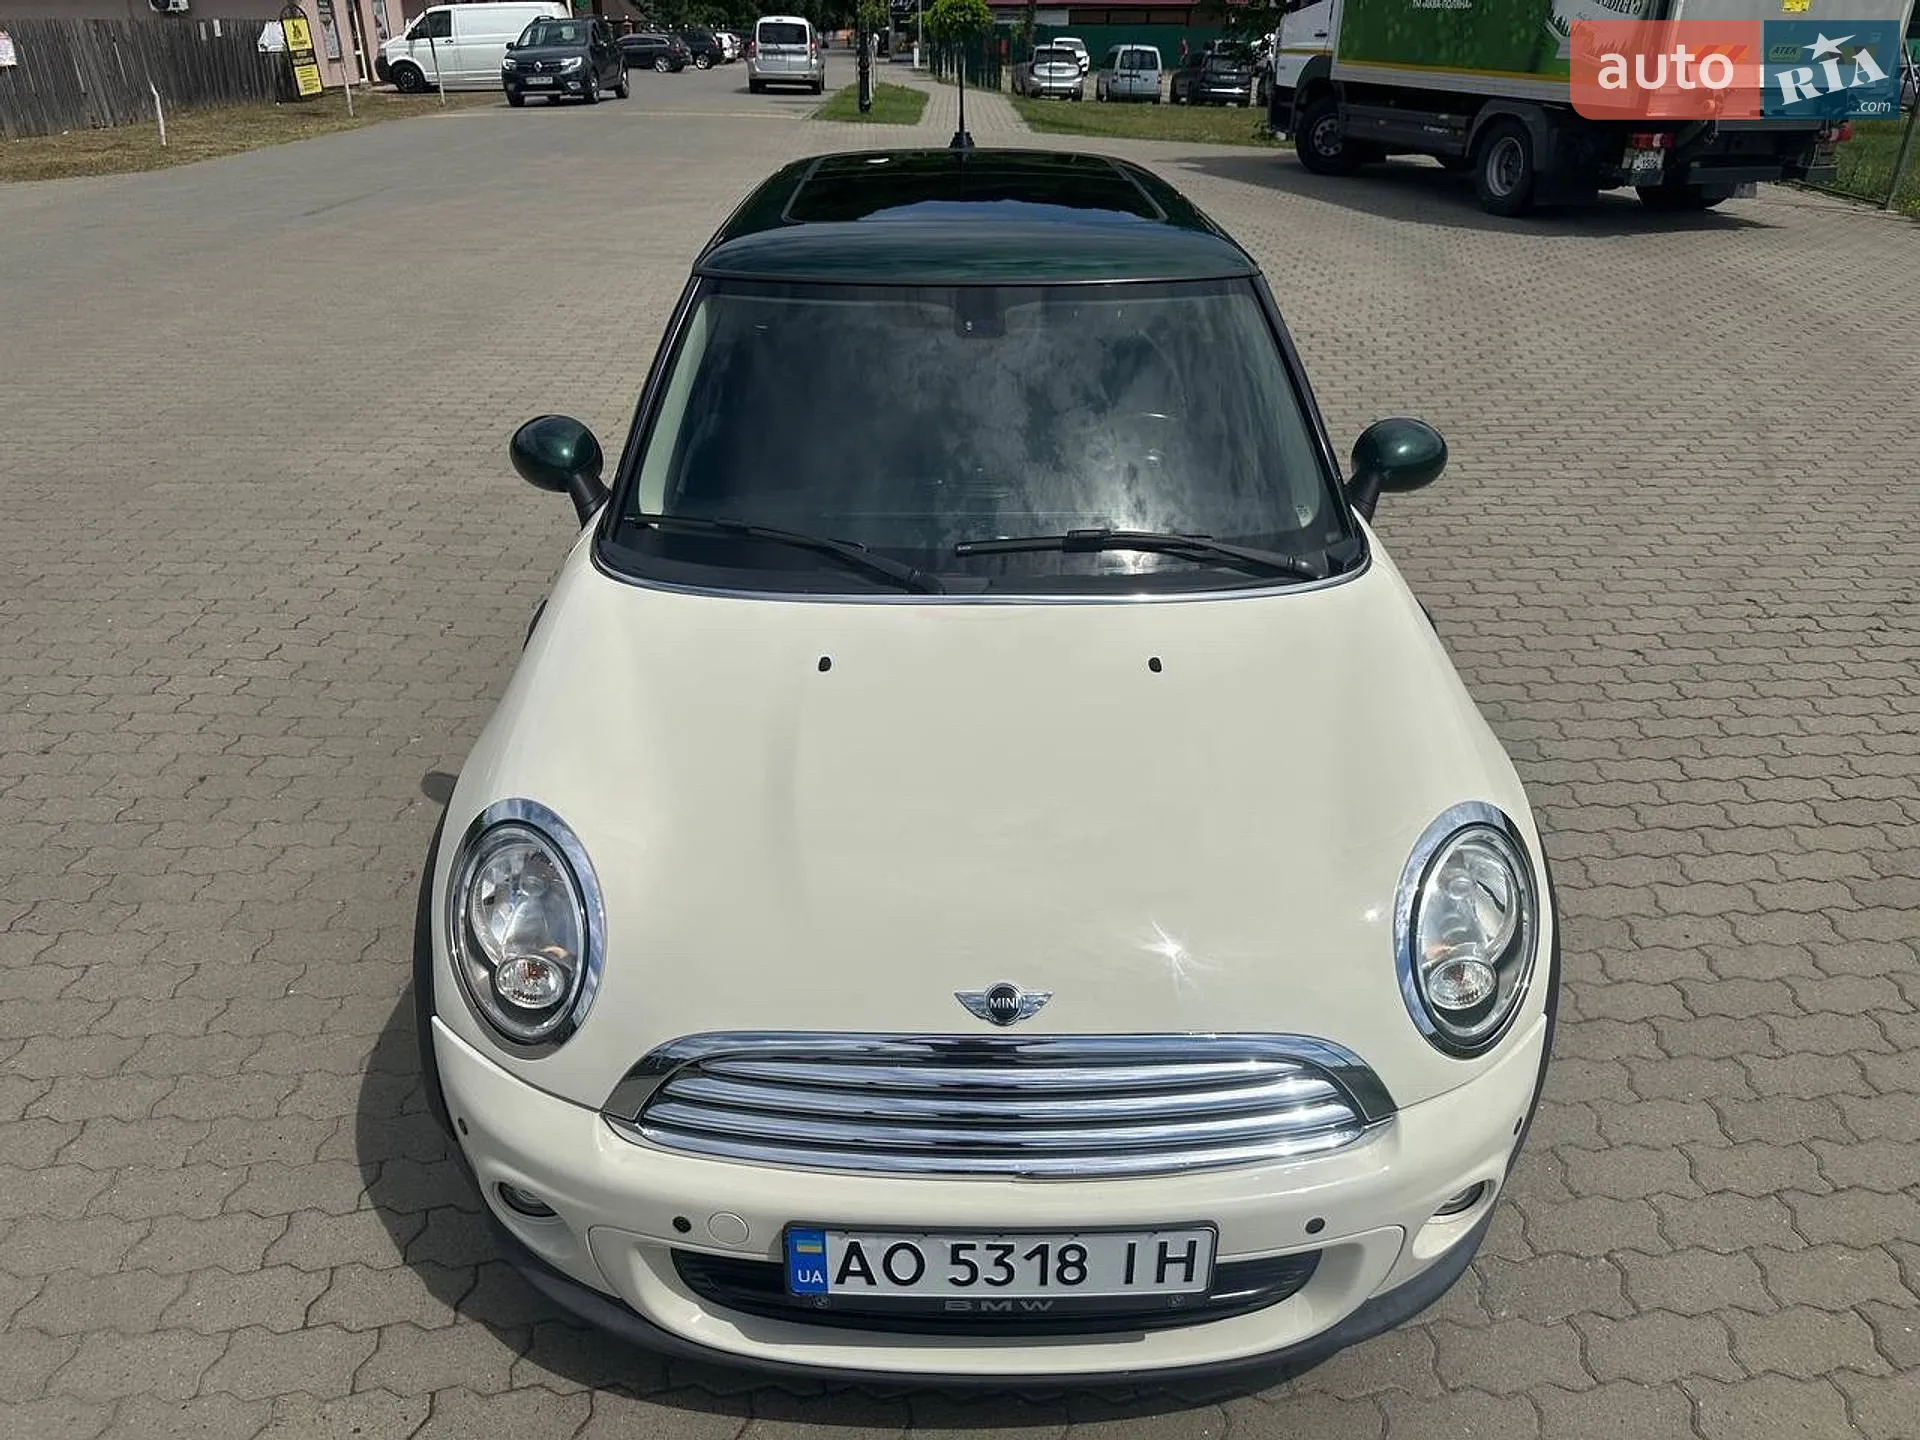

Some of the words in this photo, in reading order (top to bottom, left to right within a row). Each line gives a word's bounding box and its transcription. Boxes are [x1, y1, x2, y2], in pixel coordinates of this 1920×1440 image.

[989, 997, 1019, 1009] MINI
[835, 1241, 926, 1286] AO
[948, 1243, 1088, 1286] 5318
[1123, 1240, 1198, 1284] IH
[798, 1270, 824, 1284] UA
[944, 1300, 1053, 1311] BMW
